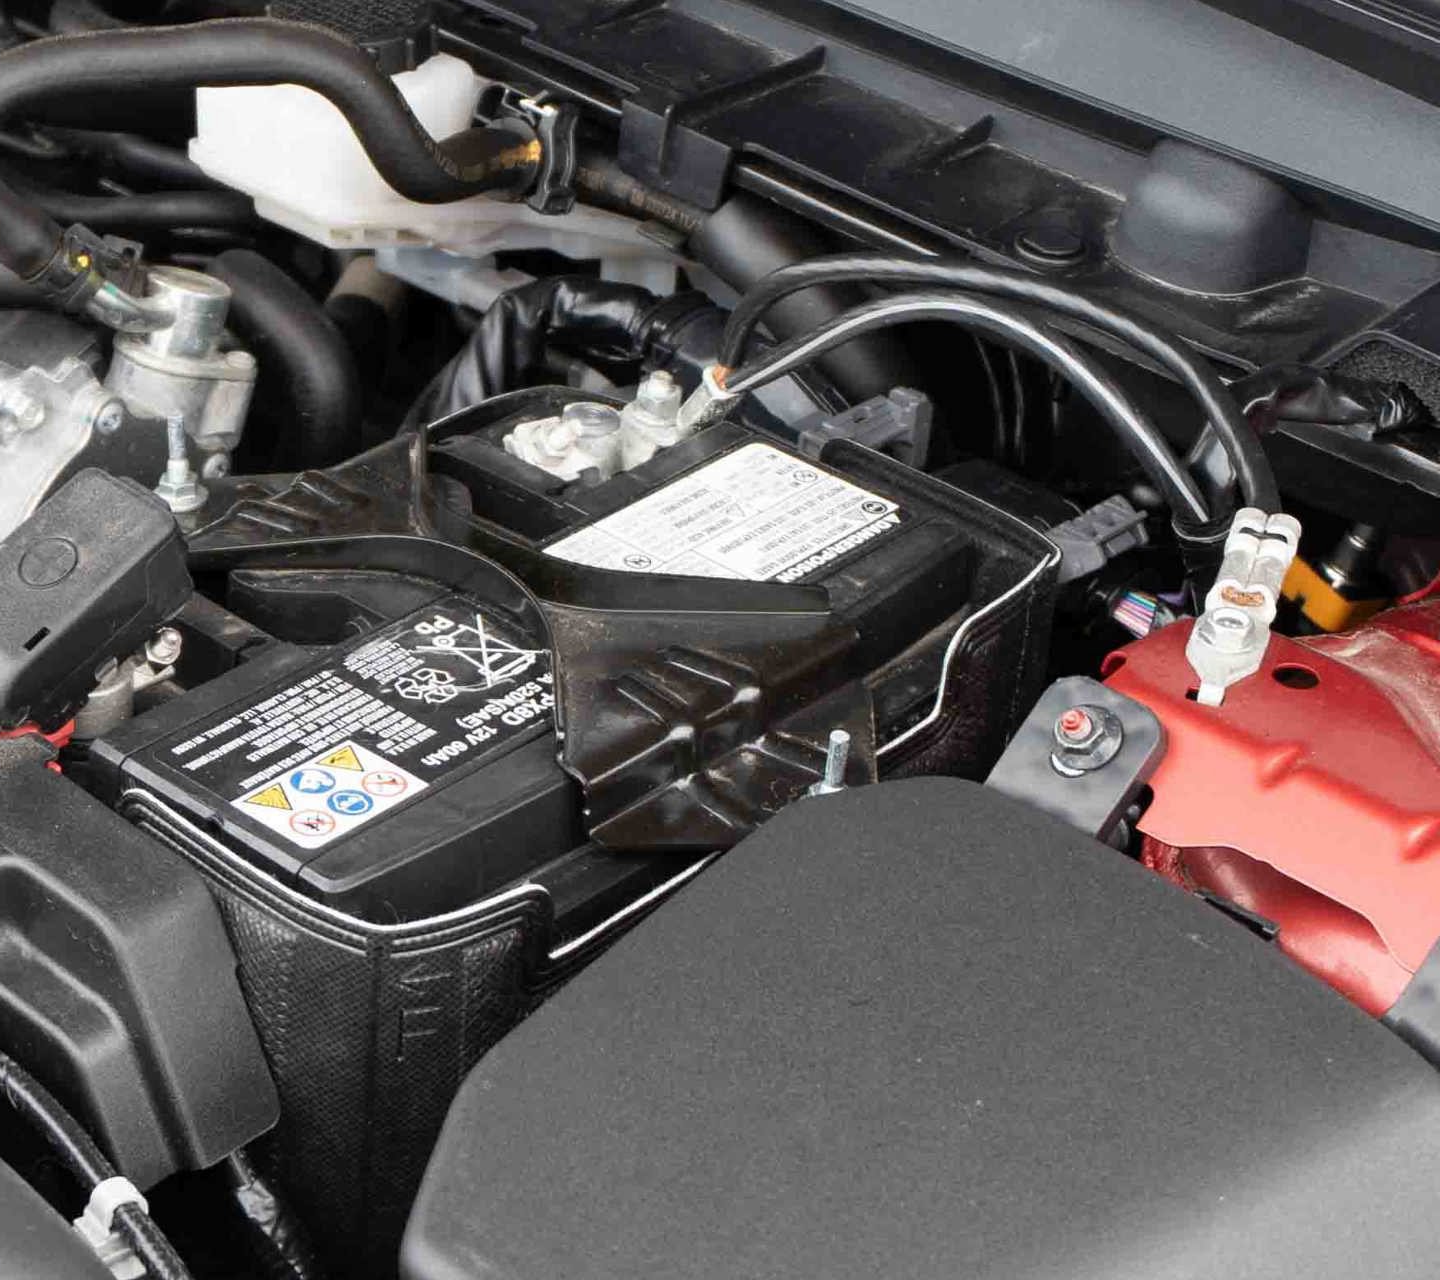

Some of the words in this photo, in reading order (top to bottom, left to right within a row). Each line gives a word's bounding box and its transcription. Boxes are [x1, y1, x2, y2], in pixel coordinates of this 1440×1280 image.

[776, 519, 892, 583] DANGER/POISON
[414, 615, 454, 634] Pb
[456, 682, 545, 729] 520A(SAE)
[465, 725, 497, 745] 12V
[421, 741, 468, 765] 60Ah
